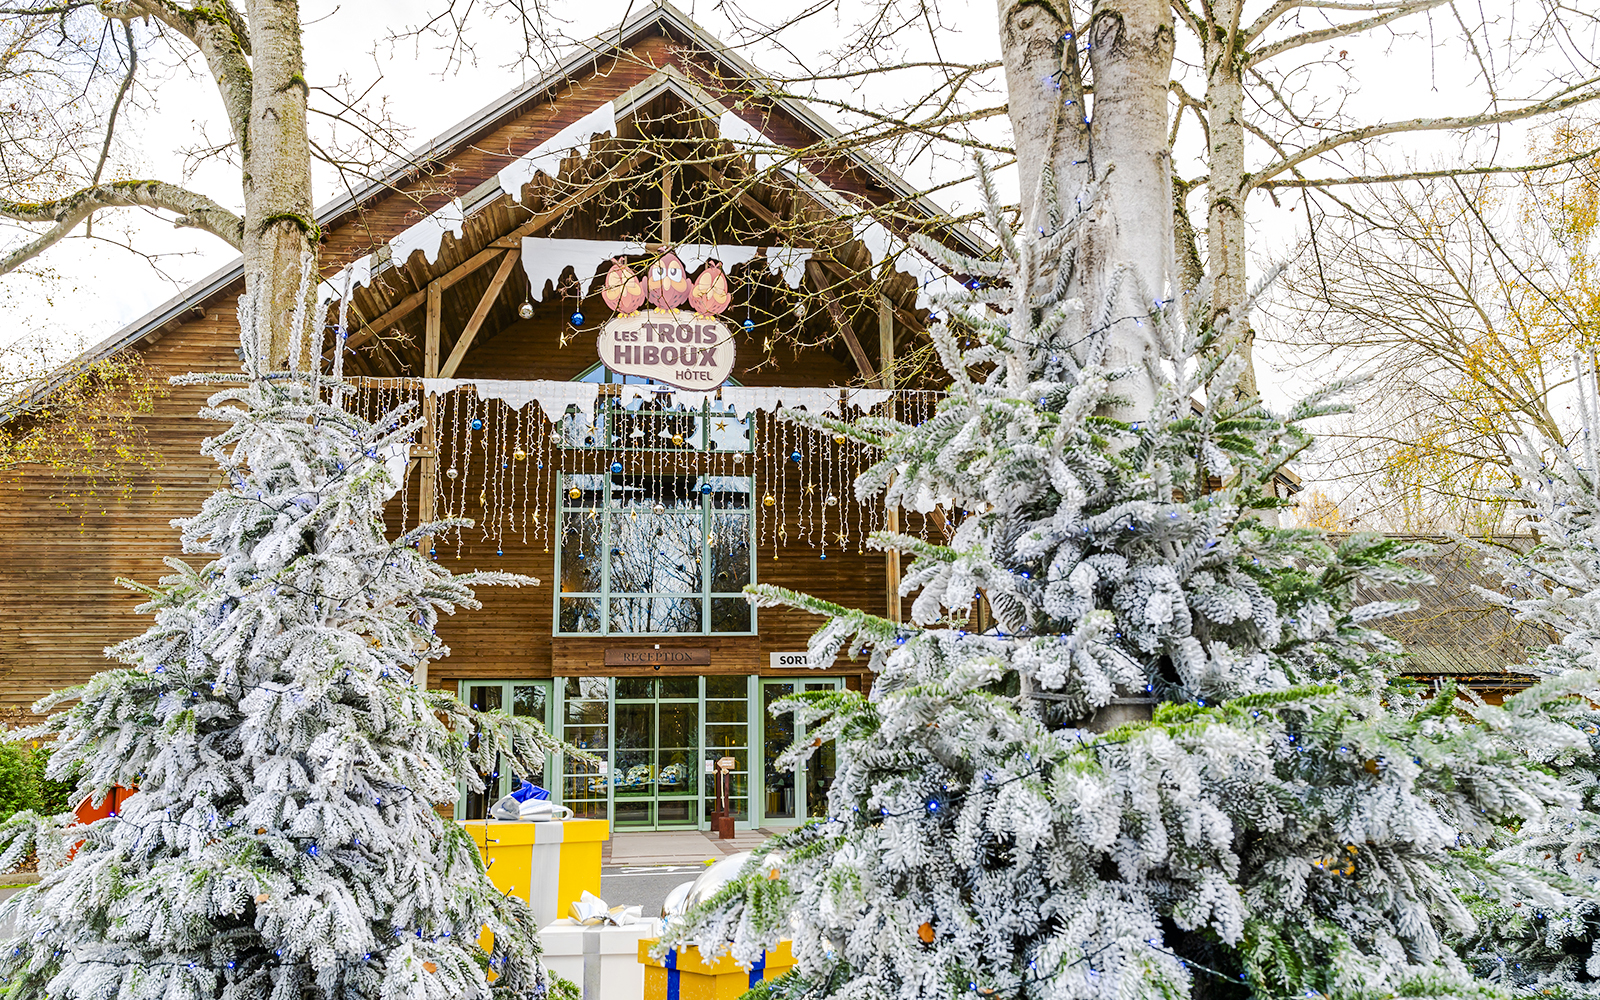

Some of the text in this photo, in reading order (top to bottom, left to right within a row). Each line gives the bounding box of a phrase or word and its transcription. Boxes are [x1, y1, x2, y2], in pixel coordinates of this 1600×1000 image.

[614, 323, 717, 344] LES TROIS
[614, 345, 717, 367] HIBOUX
[675, 368, 713, 381] HÔTEL
[623, 652, 693, 662] RECEPTION
[779, 655, 807, 665] SORT
